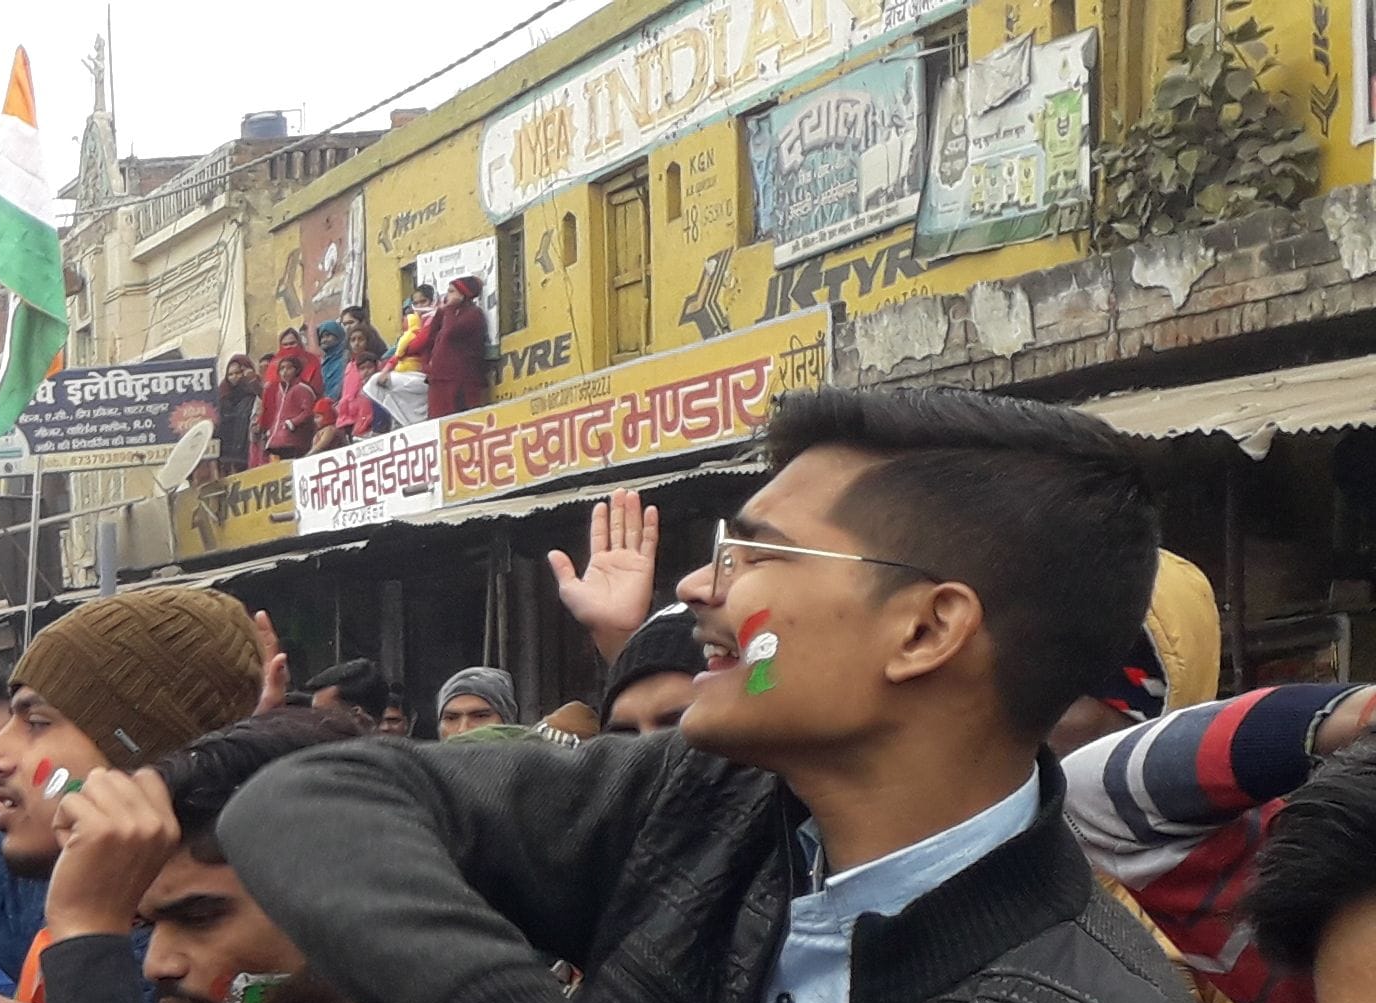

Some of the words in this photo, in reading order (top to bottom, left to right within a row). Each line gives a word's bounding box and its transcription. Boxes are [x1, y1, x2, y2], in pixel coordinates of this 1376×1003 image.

[446, 413, 517, 496] सिंह
[521, 400, 617, 478] खाद
[619, 355, 774, 452] भण्डार
